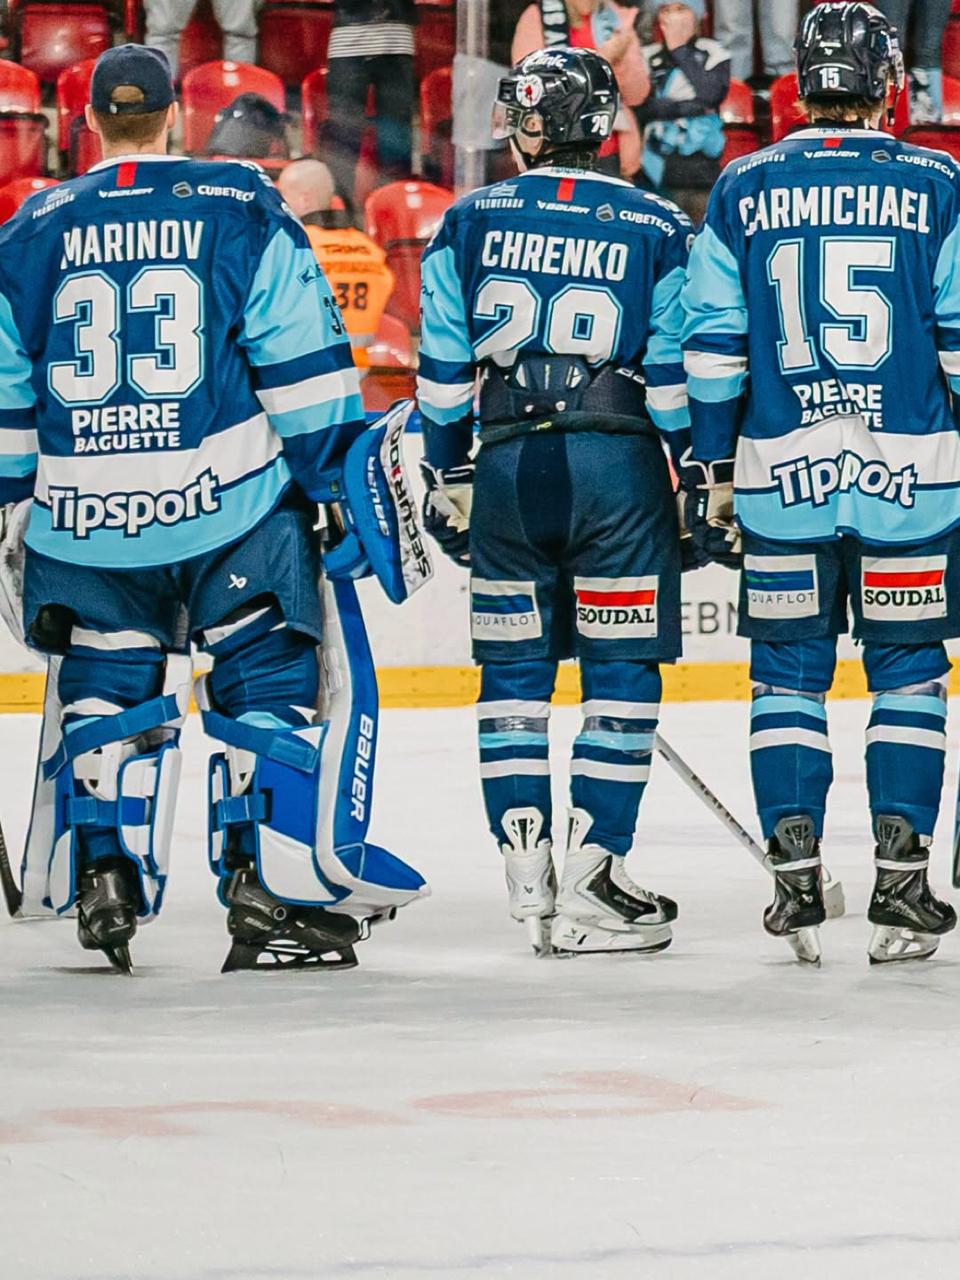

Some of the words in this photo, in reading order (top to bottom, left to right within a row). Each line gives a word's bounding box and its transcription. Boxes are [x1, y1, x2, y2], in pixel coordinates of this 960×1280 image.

[819, 66, 840, 89] 15
[814, 150, 861, 159] BAUER
[896, 154, 955, 179] CUBETECH
[548, 202, 591, 215] BAUER
[738, 185, 931, 236] CARMICHAEL
[618, 209, 676, 238] CUBETECH
[60, 220, 204, 270] MARINOV
[481, 230, 630, 281] CHRENKO
[766, 235, 897, 376] 15
[473, 273, 624, 369] 29
[48, 264, 206, 408] 33
[72, 402, 181, 436] PIERRE
[73, 431, 182, 454] BAGUETTE
[49, 468, 219, 539] Tipsport
[750, 591, 816, 605] QUAFLOT
[864, 587, 945, 608] SOUDAL
[475, 612, 538, 627] QUAFLOT
[578, 607, 655, 626] SOUDAL
[351, 712, 374, 824] BAUER
